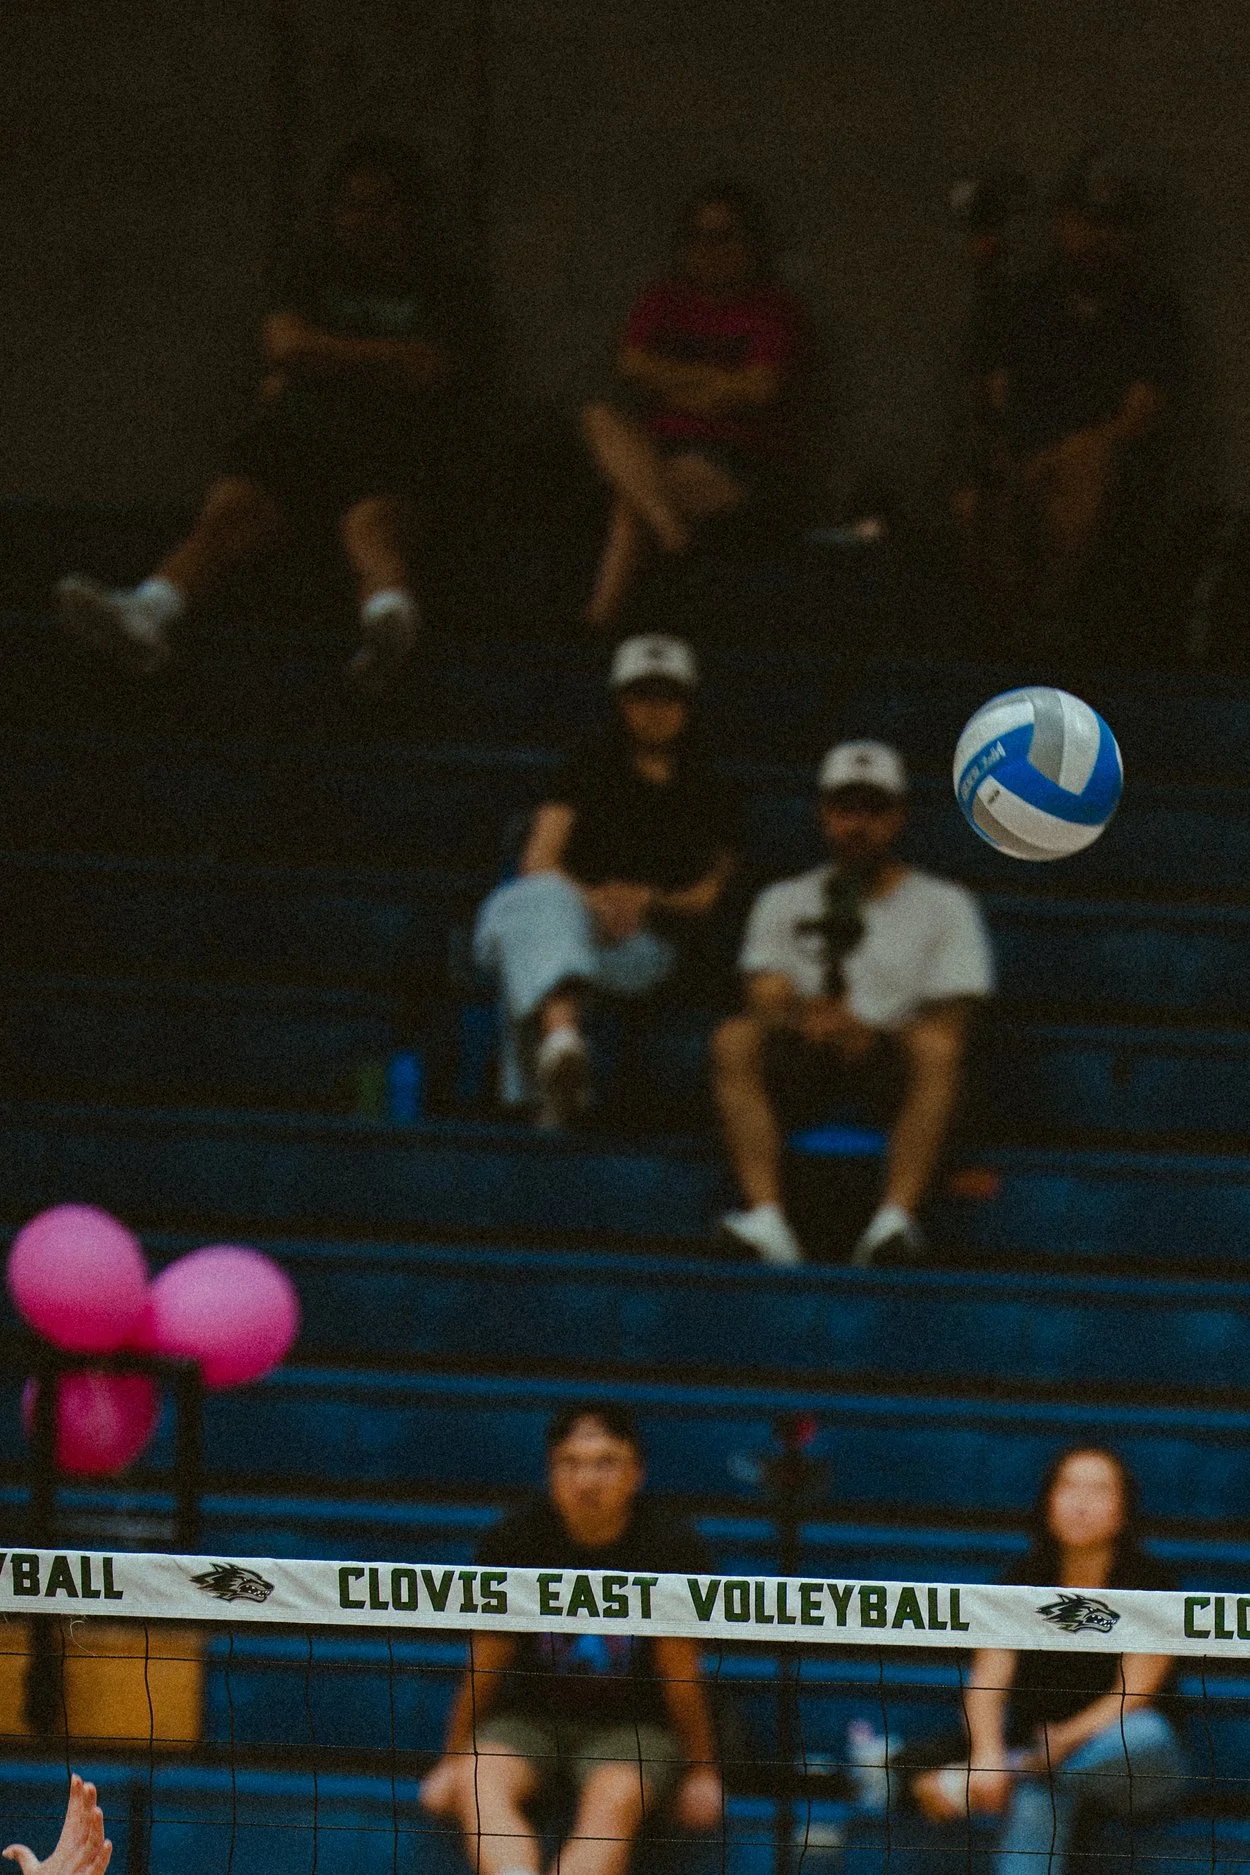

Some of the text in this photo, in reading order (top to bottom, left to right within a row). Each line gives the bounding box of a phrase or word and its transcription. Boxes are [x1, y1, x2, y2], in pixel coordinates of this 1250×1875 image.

[338, 1566, 970, 1632] CLOVIS EAST VOLLEYBALL
